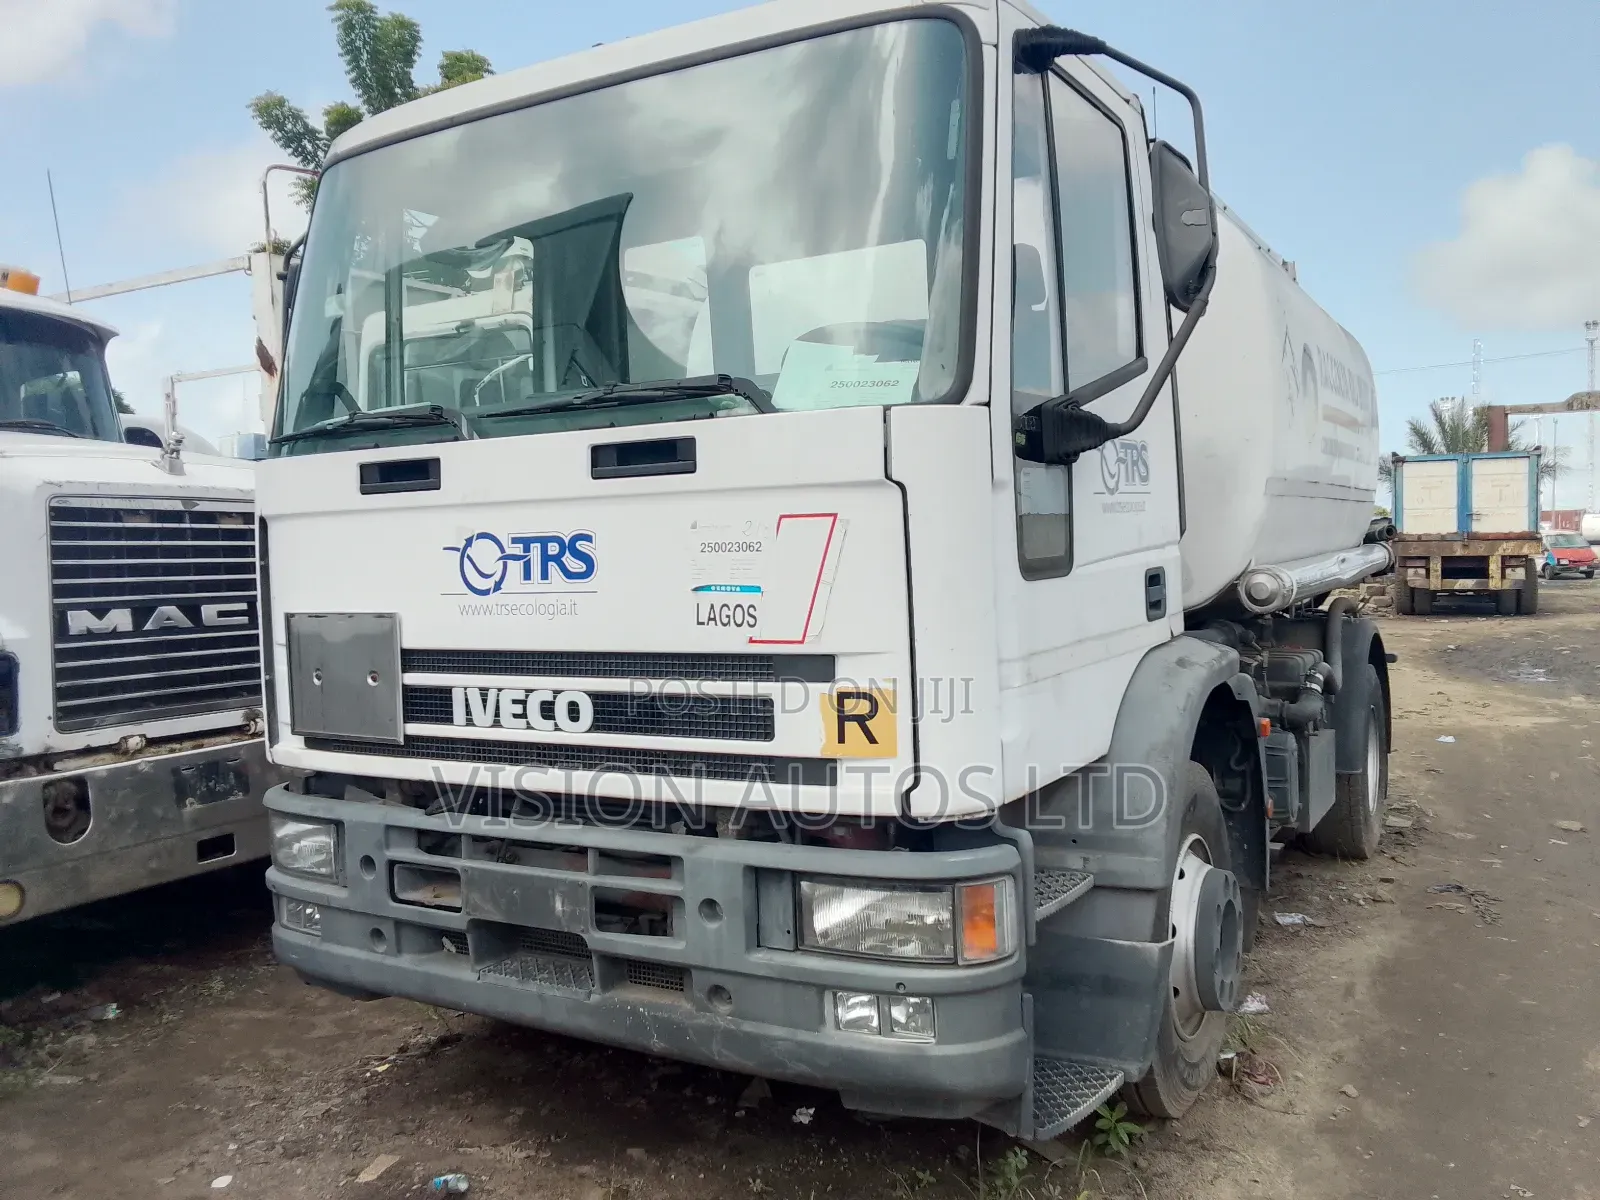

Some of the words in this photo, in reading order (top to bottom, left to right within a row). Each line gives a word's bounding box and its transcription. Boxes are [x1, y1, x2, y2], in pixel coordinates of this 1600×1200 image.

[829, 380, 900, 389] 250023062
[1118, 440, 1149, 485] TRS
[509, 531, 597, 583] TRS
[700, 541, 762, 553] 250023062
[67, 602, 261, 635] MAC
[458, 599, 579, 621] www.trsecologia.it
[696, 602, 758, 628] LAGOS
[451, 687, 594, 733] IVECO
[836, 691, 880, 745] R
